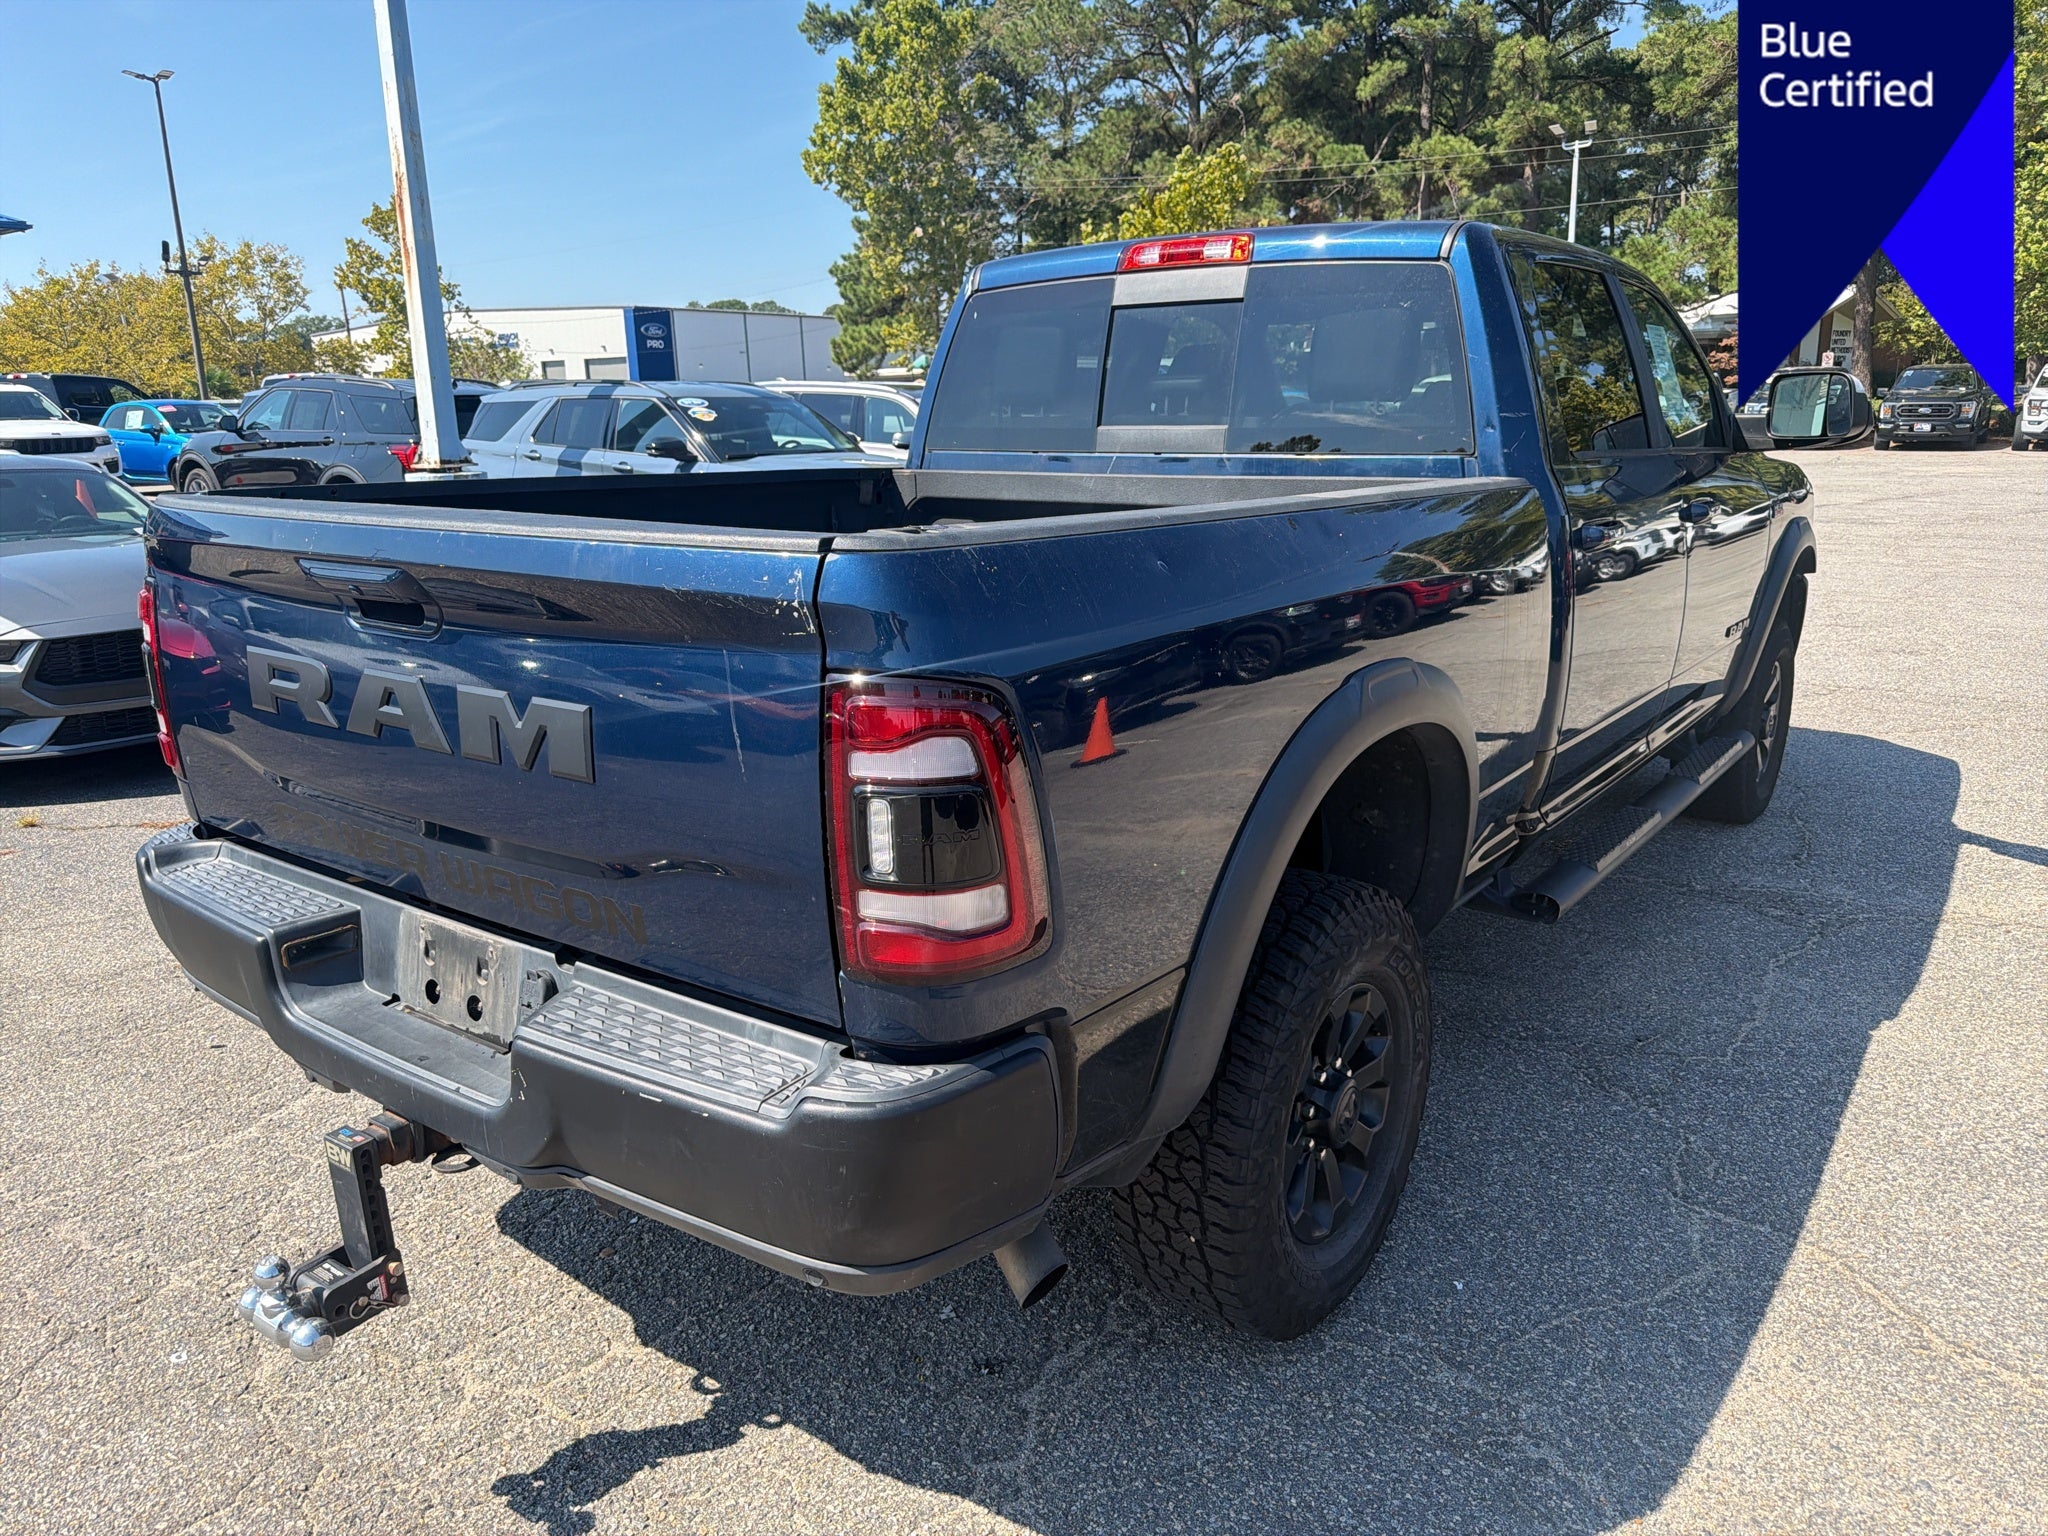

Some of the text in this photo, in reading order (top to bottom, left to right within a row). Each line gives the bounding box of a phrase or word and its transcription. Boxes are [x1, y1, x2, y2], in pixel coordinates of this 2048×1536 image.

[646, 339, 665, 349] PRO
[1832, 329, 1852, 337] FOUNDRY
[246, 645, 596, 784] RAM
[273, 803, 650, 946] POWER WAGON
